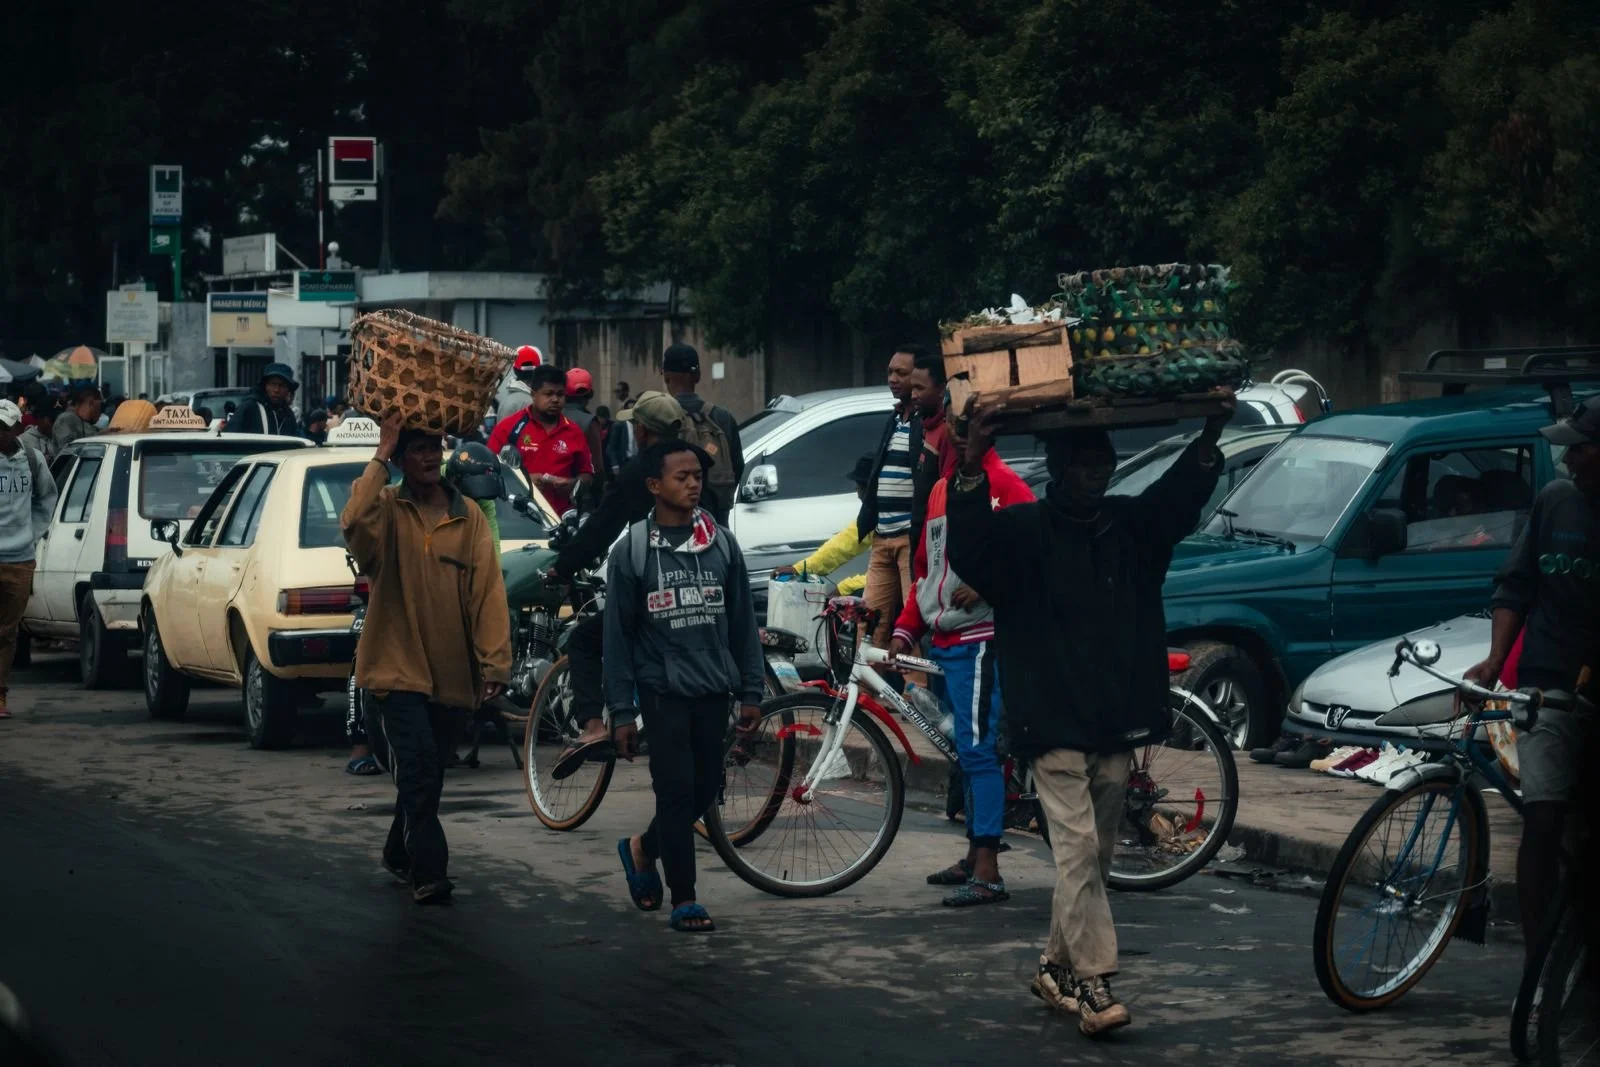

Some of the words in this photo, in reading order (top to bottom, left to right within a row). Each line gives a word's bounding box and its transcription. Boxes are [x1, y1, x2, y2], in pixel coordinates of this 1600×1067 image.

[165, 409, 190, 418] TAXI
[347, 422, 373, 431] TAXI
[904, 703, 949, 749] SHIMANO
